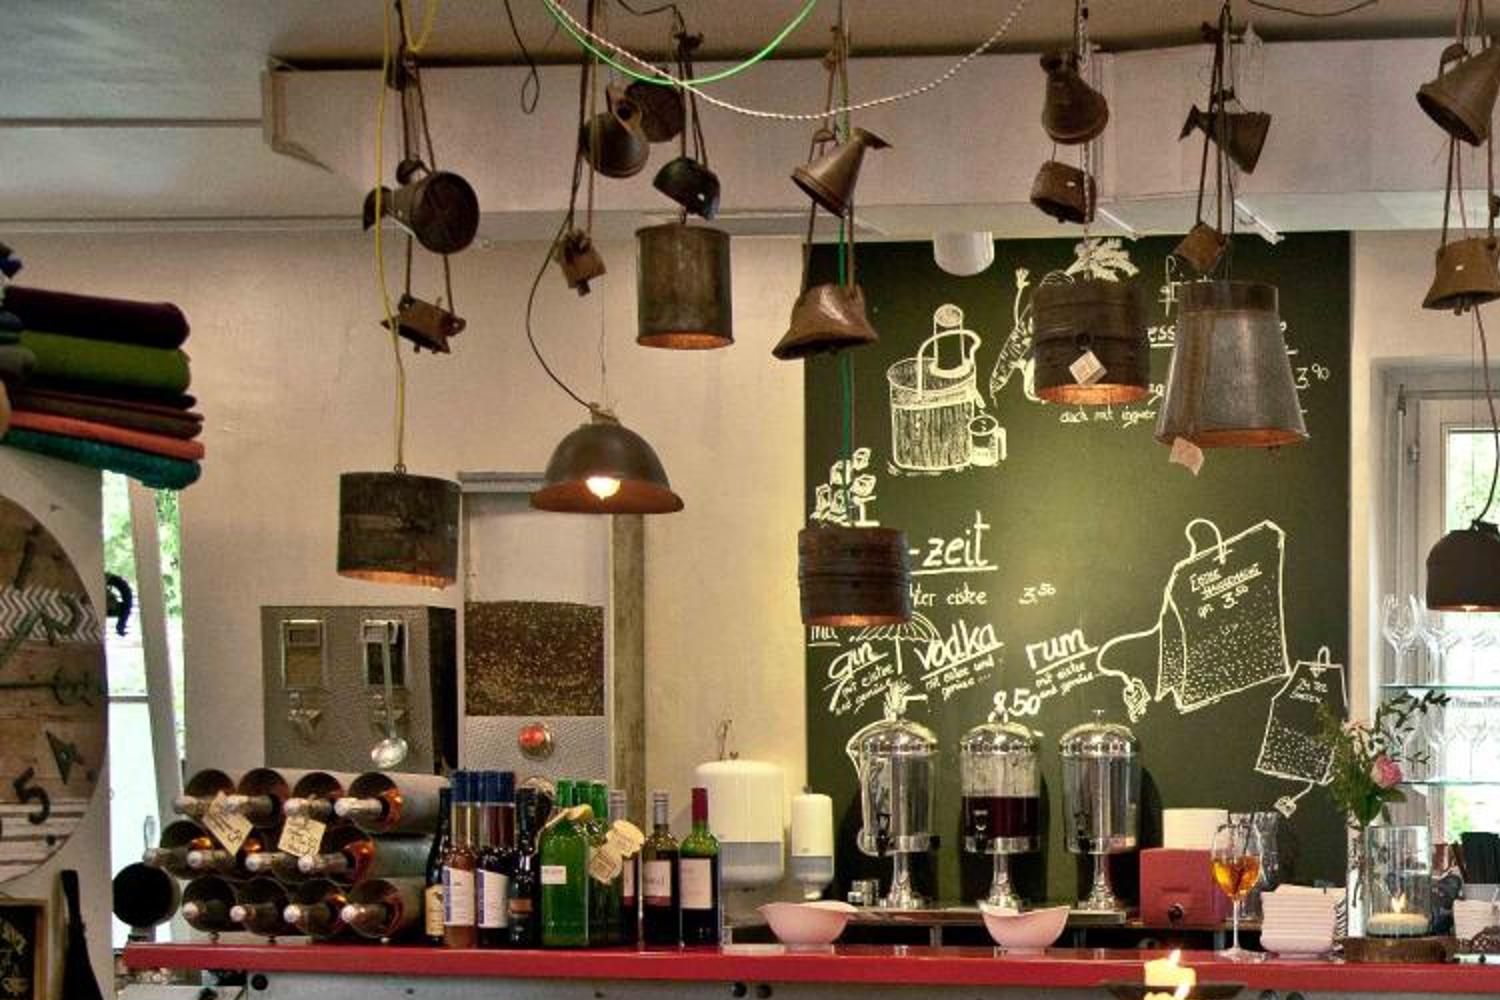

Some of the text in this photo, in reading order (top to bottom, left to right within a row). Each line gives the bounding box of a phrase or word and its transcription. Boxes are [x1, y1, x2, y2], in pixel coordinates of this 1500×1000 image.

[914, 619, 1001, 671] vodka
[1025, 627, 1091, 671] rum
[827, 641, 882, 713] gin
